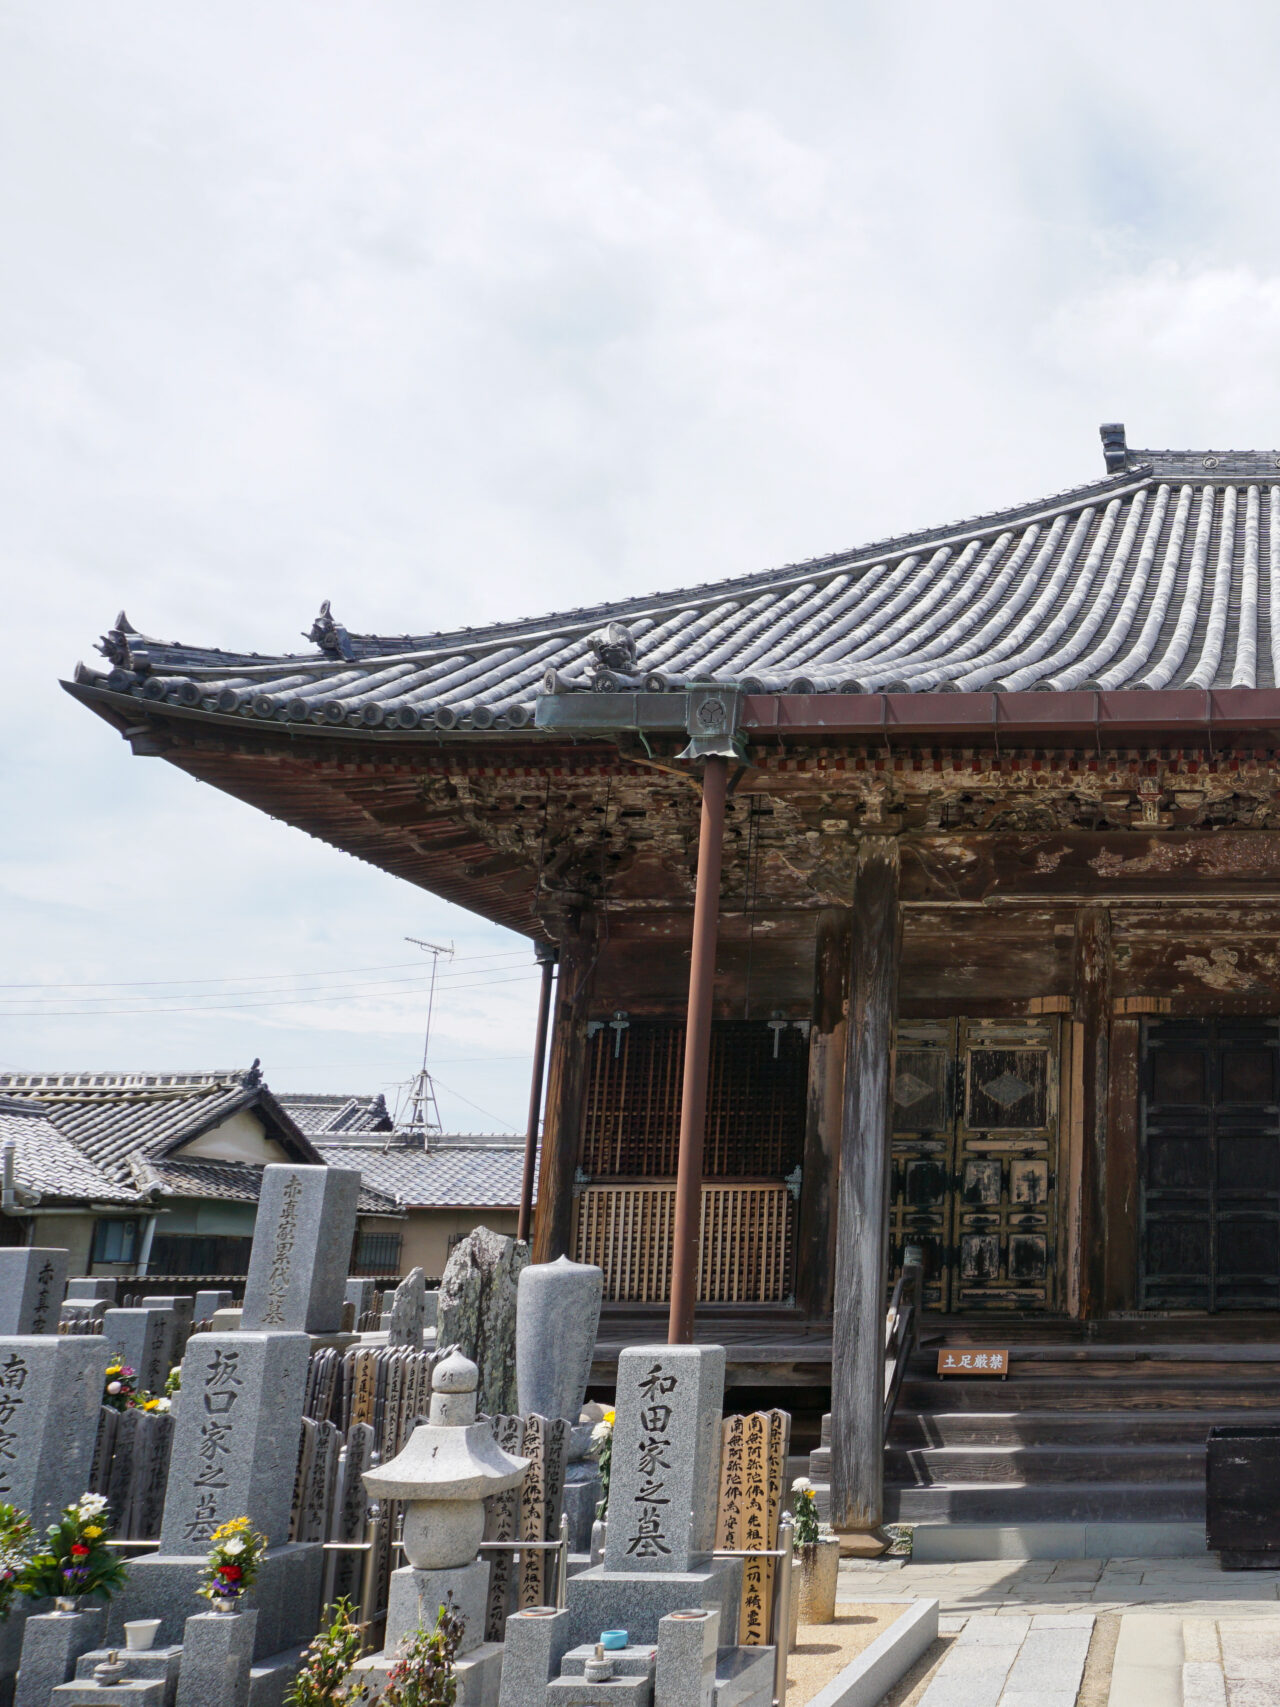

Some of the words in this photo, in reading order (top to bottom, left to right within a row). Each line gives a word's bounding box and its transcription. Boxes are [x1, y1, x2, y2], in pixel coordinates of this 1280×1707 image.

[182, 1349, 244, 1543] 坂口家之墓
[942, 1354, 1004, 1370] 土足厳禁
[625, 1363, 679, 1558] 和田家之墓
